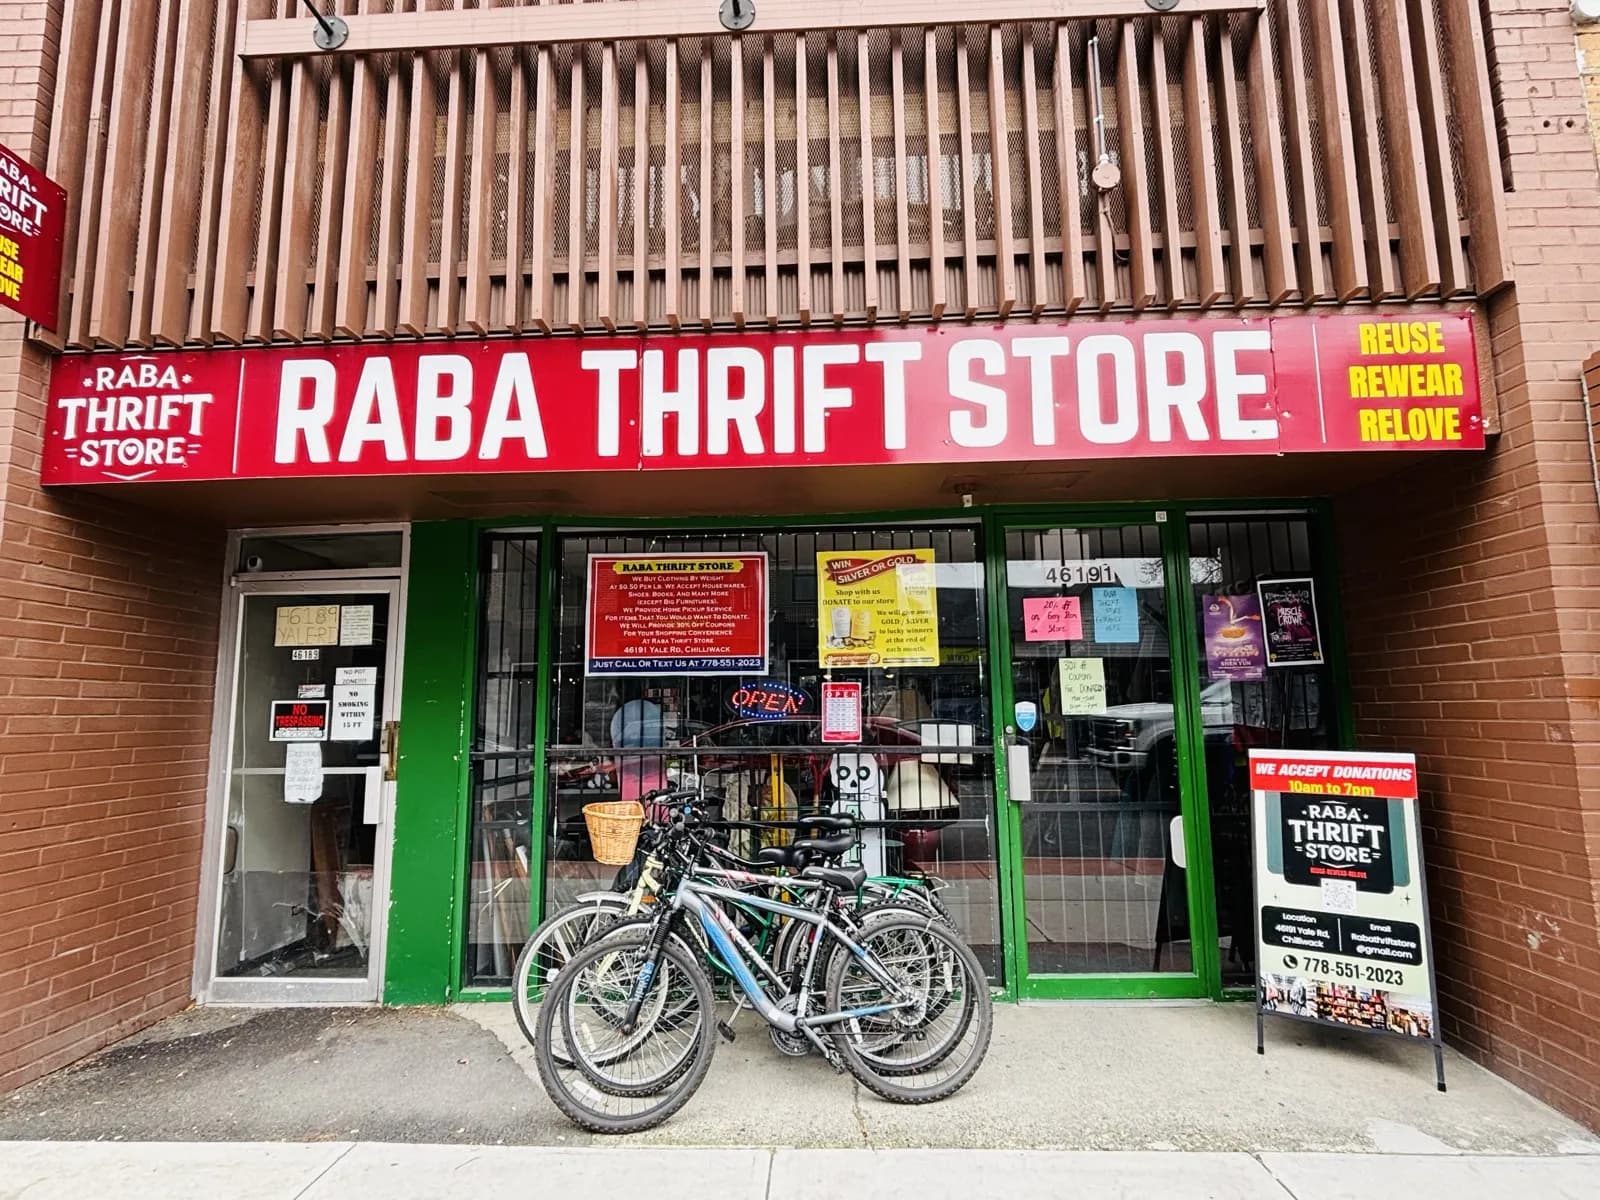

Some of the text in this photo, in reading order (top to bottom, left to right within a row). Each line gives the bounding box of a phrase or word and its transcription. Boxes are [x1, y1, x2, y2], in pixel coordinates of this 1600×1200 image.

[1358, 321, 1446, 355] REUSE
[96, 364, 180, 391] RABA
[1348, 363, 1464, 398] REWEAR
[274, 329, 1280, 464] RABA THRIFT STORE
[58, 393, 214, 440] THRIFT
[1359, 407, 1462, 442] RELOVE
[80, 436, 186, 467] STORE
[622, 562, 734, 572] RABA THRIFT STORE
[832, 560, 852, 570] WIN
[838, 556, 914, 585] SILVER OR GOLD
[1046, 566, 1112, 583] 46191
[279, 607, 337, 625] 46189
[293, 649, 319, 660] 46189
[700, 658, 760, 666] 778-551-2023
[292, 704, 308, 716] NO
[732, 689, 805, 714] OPEN
[276, 715, 324, 728] TRESPASSING
[1255, 763, 1412, 781] WE ACCEPT DONATIONS
[1288, 780, 1323, 793] 10am
[1326, 782, 1341, 794] to
[1309, 805, 1360, 822] RABA
[1288, 819, 1384, 850] THRIFT
[1306, 843, 1372, 864] STORE
[1282, 912, 1317, 924] Location
[1298, 926, 1316, 937] Yale
[1282, 935, 1324, 948] Chilliwack
[1303, 957, 1404, 986] 778-551-2023
